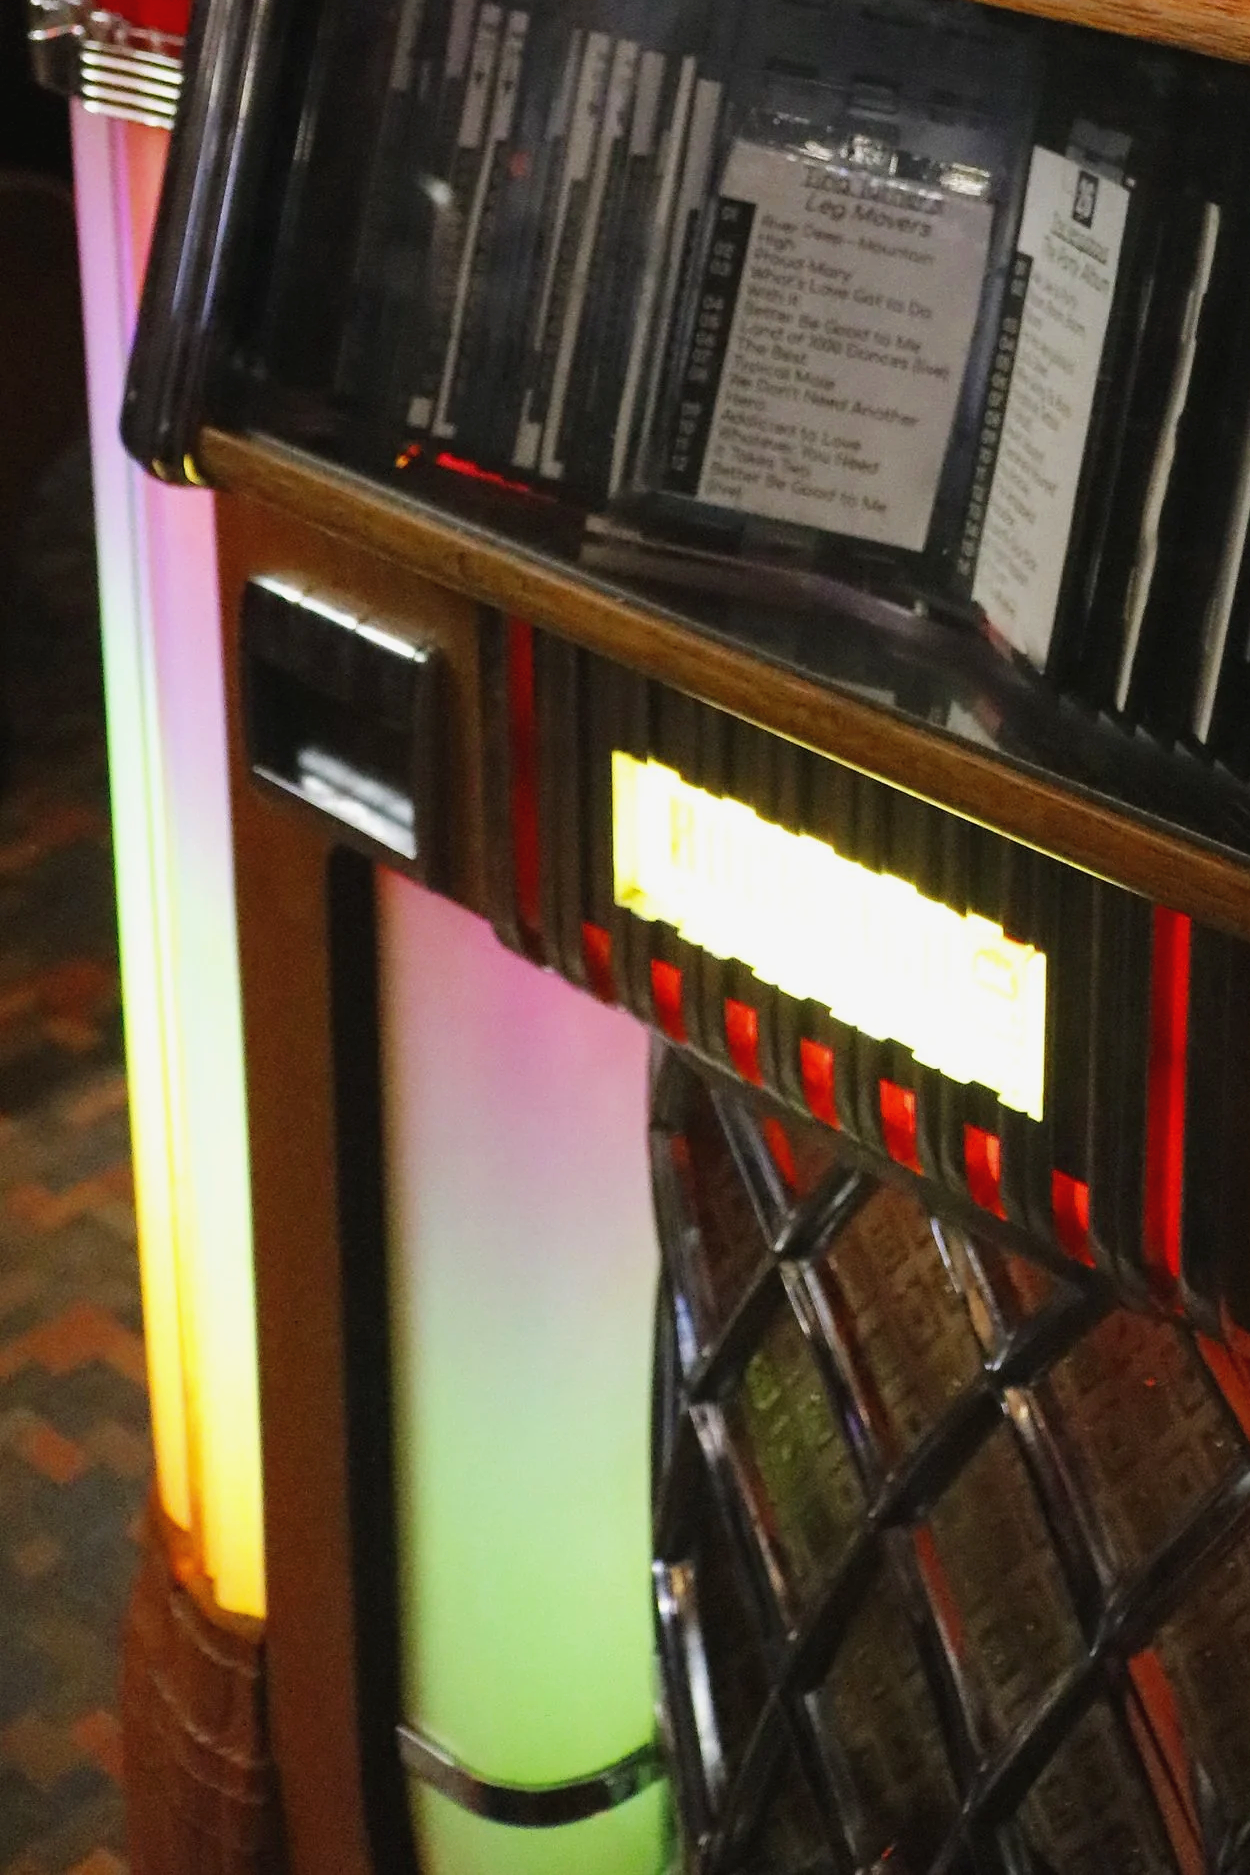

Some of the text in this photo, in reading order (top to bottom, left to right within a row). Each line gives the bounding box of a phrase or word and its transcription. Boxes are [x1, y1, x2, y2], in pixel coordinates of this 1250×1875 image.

[805, 193, 931, 237] Leg Movers
[907, 301, 933, 318] Do
